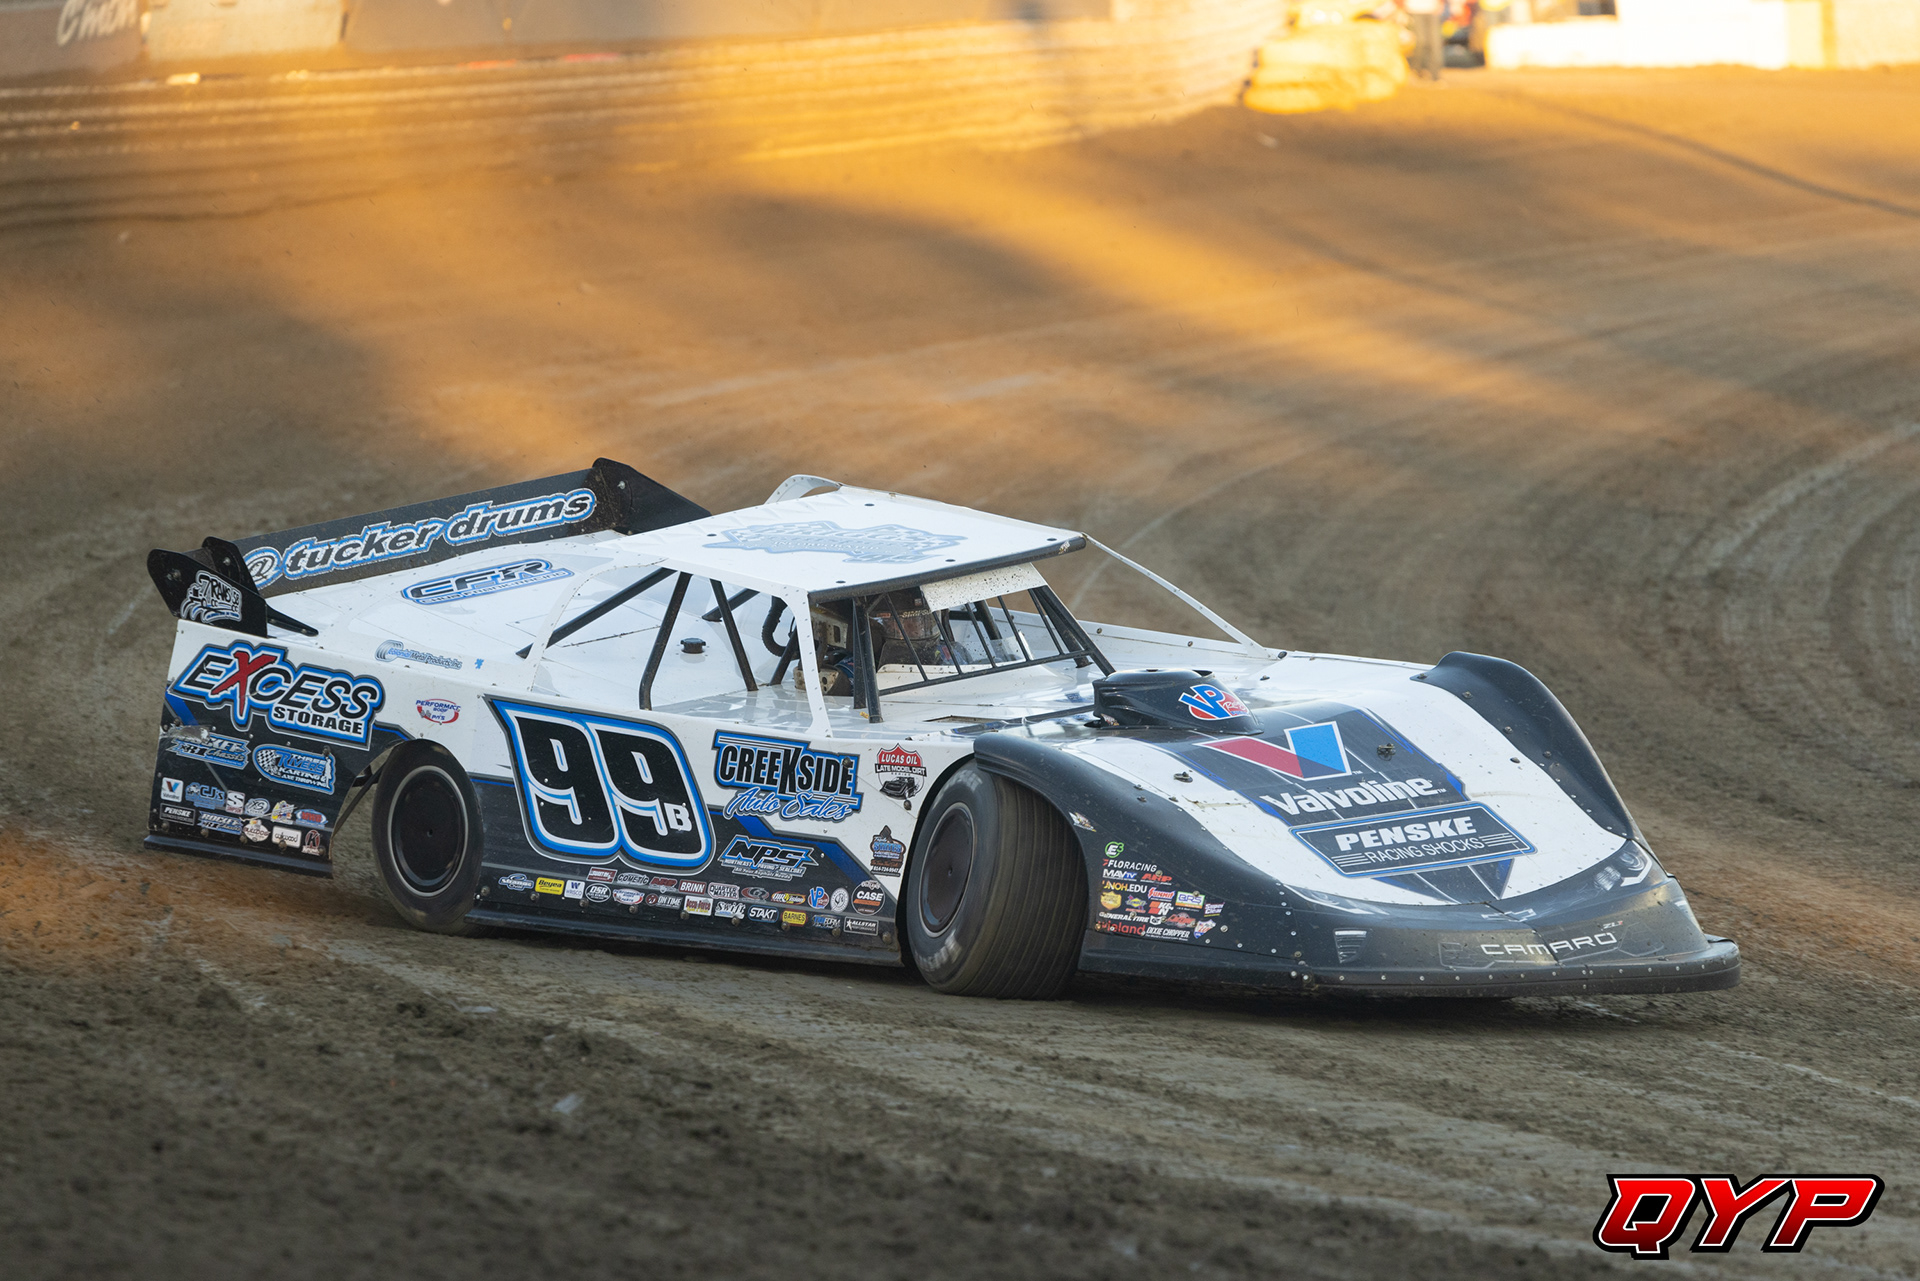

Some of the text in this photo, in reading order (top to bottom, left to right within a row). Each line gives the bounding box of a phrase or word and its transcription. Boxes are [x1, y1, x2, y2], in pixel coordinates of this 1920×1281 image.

[287, 523, 445, 572] tucker
[449, 494, 591, 538] drums
[184, 651, 378, 720] EXCESS
[1178, 684, 1231, 720] VP
[273, 707, 363, 735] STORAGE
[276, 751, 326, 774] RIVERS
[881, 753, 918, 765] LUCAS OIL
[279, 767, 320, 780] KARTING
[719, 745, 854, 796] CREEKSIDE
[876, 764, 926, 776] LATE MODEL DIRT
[1260, 777, 1440, 816] Valvoline
[727, 787, 853, 820] Auto Sales
[164, 806, 192, 818] PENSKE
[1335, 816, 1477, 852] PENSKE
[725, 840, 806, 868] NPS
[1365, 837, 1485, 864] RACING SHOCKS
[1107, 859, 1157, 873] FLORACING
[1103, 869, 1138, 879] MAVTV
[538, 880, 562, 888] Beyea
[589, 885, 608, 895] DSR
[680, 881, 705, 893] BRINN
[856, 890, 884, 901] CASE
[749, 907, 777, 919] STAKT
[783, 911, 806, 923] BARNES
[851, 920, 877, 928] ALLSTAR
[1146, 926, 1163, 936] DIXIE
[1162, 928, 1191, 938] CHOPPER
[1480, 932, 1618, 955] CAMARO
